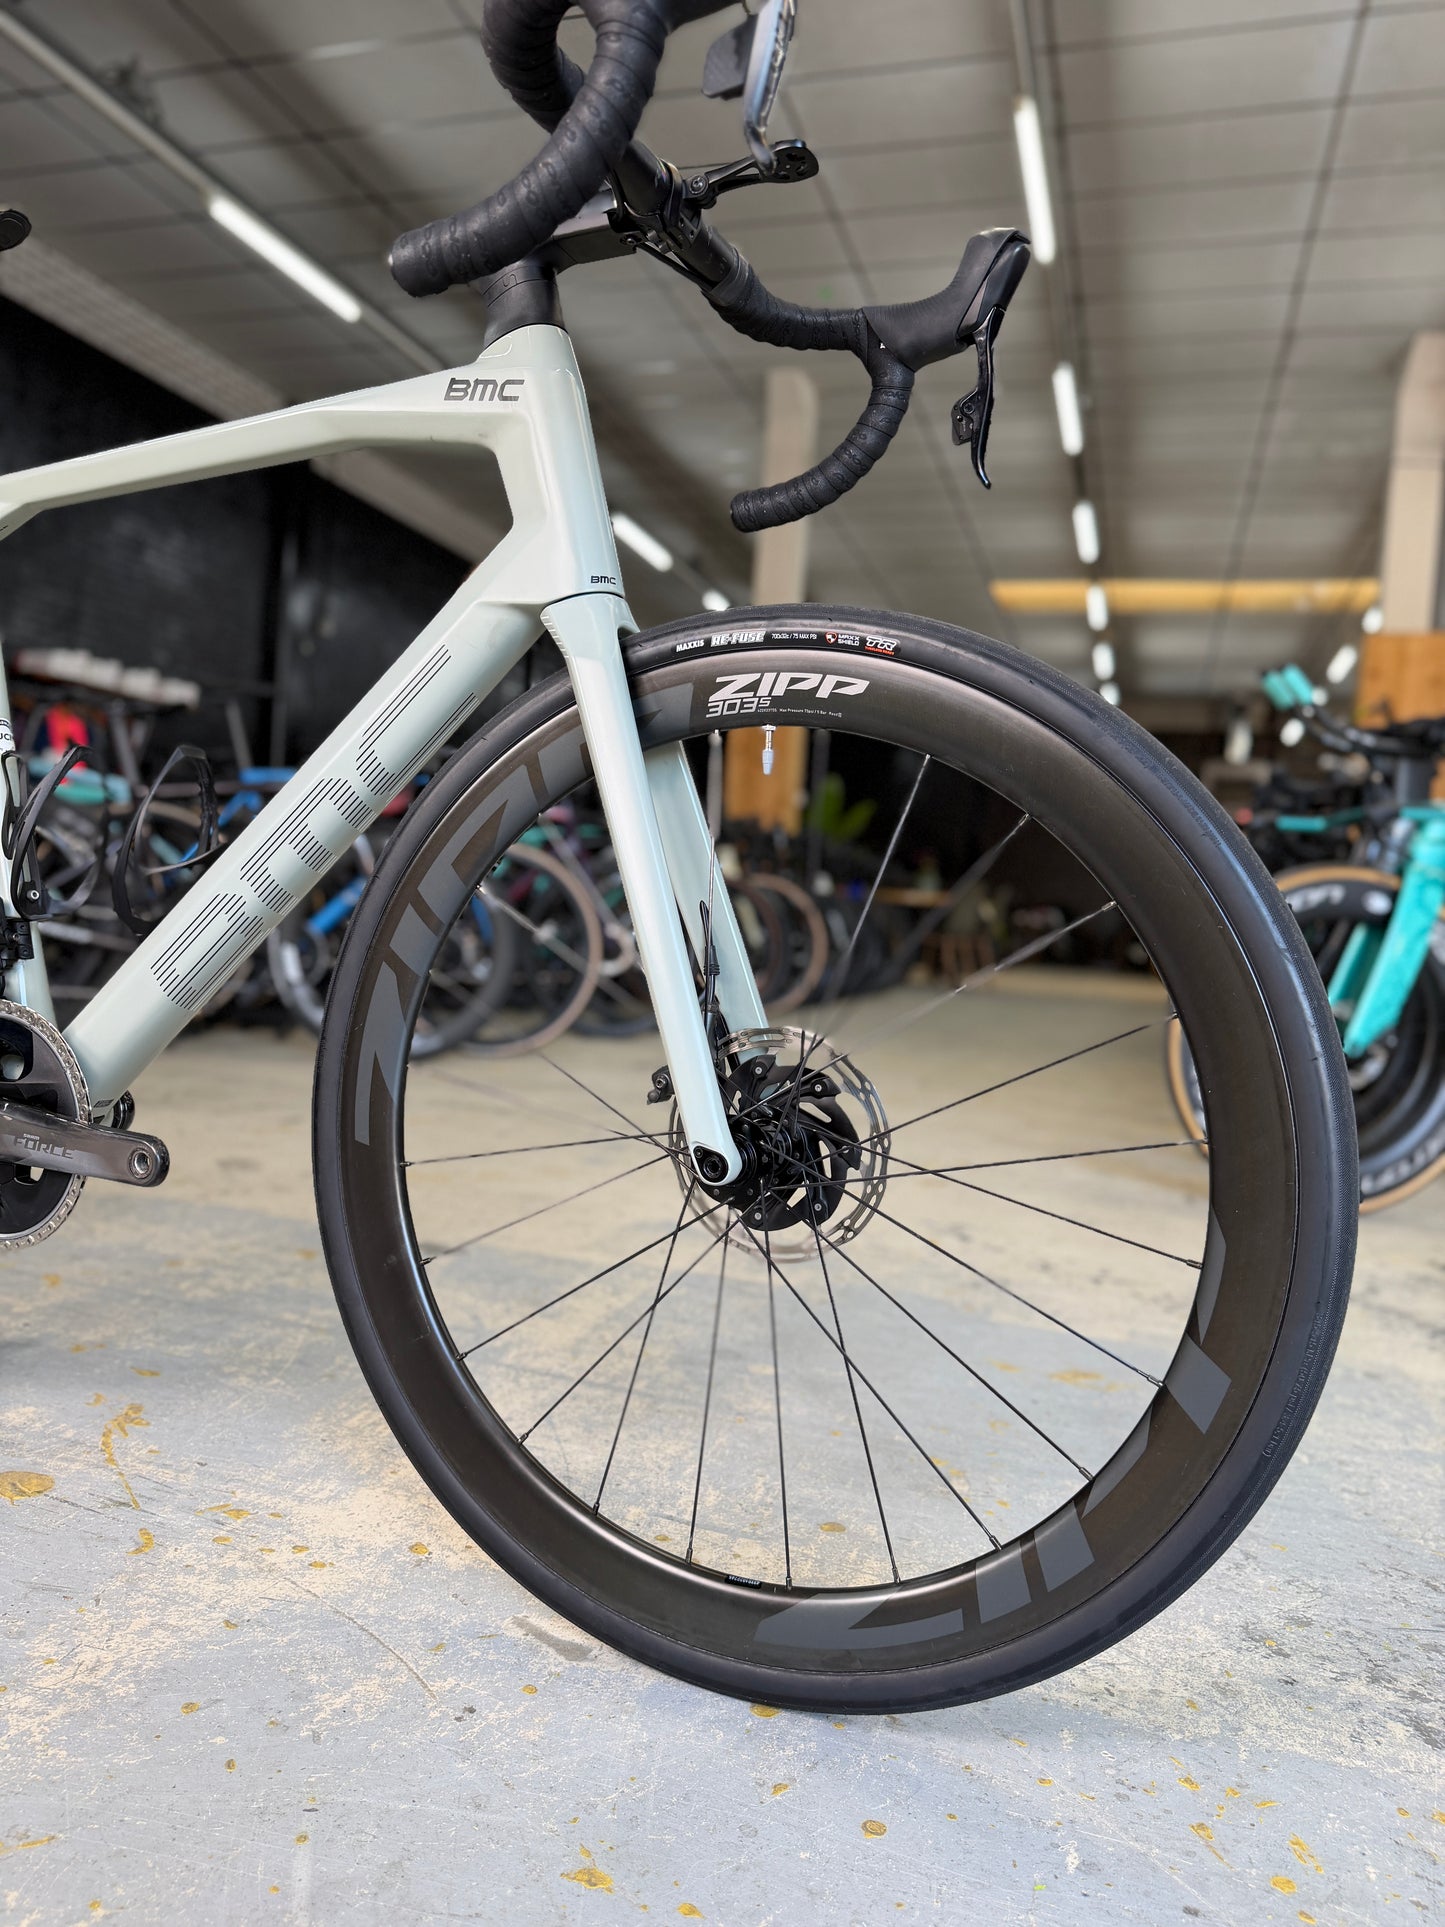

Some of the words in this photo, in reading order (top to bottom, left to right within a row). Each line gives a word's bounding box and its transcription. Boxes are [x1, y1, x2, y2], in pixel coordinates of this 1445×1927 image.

[444, 377, 525, 402] BMC
[590, 574, 617, 586] BMC
[675, 639, 705, 653] MAXXIS
[708, 671, 870, 703] ZIPP
[14, 1136, 73, 1160] FORCE
